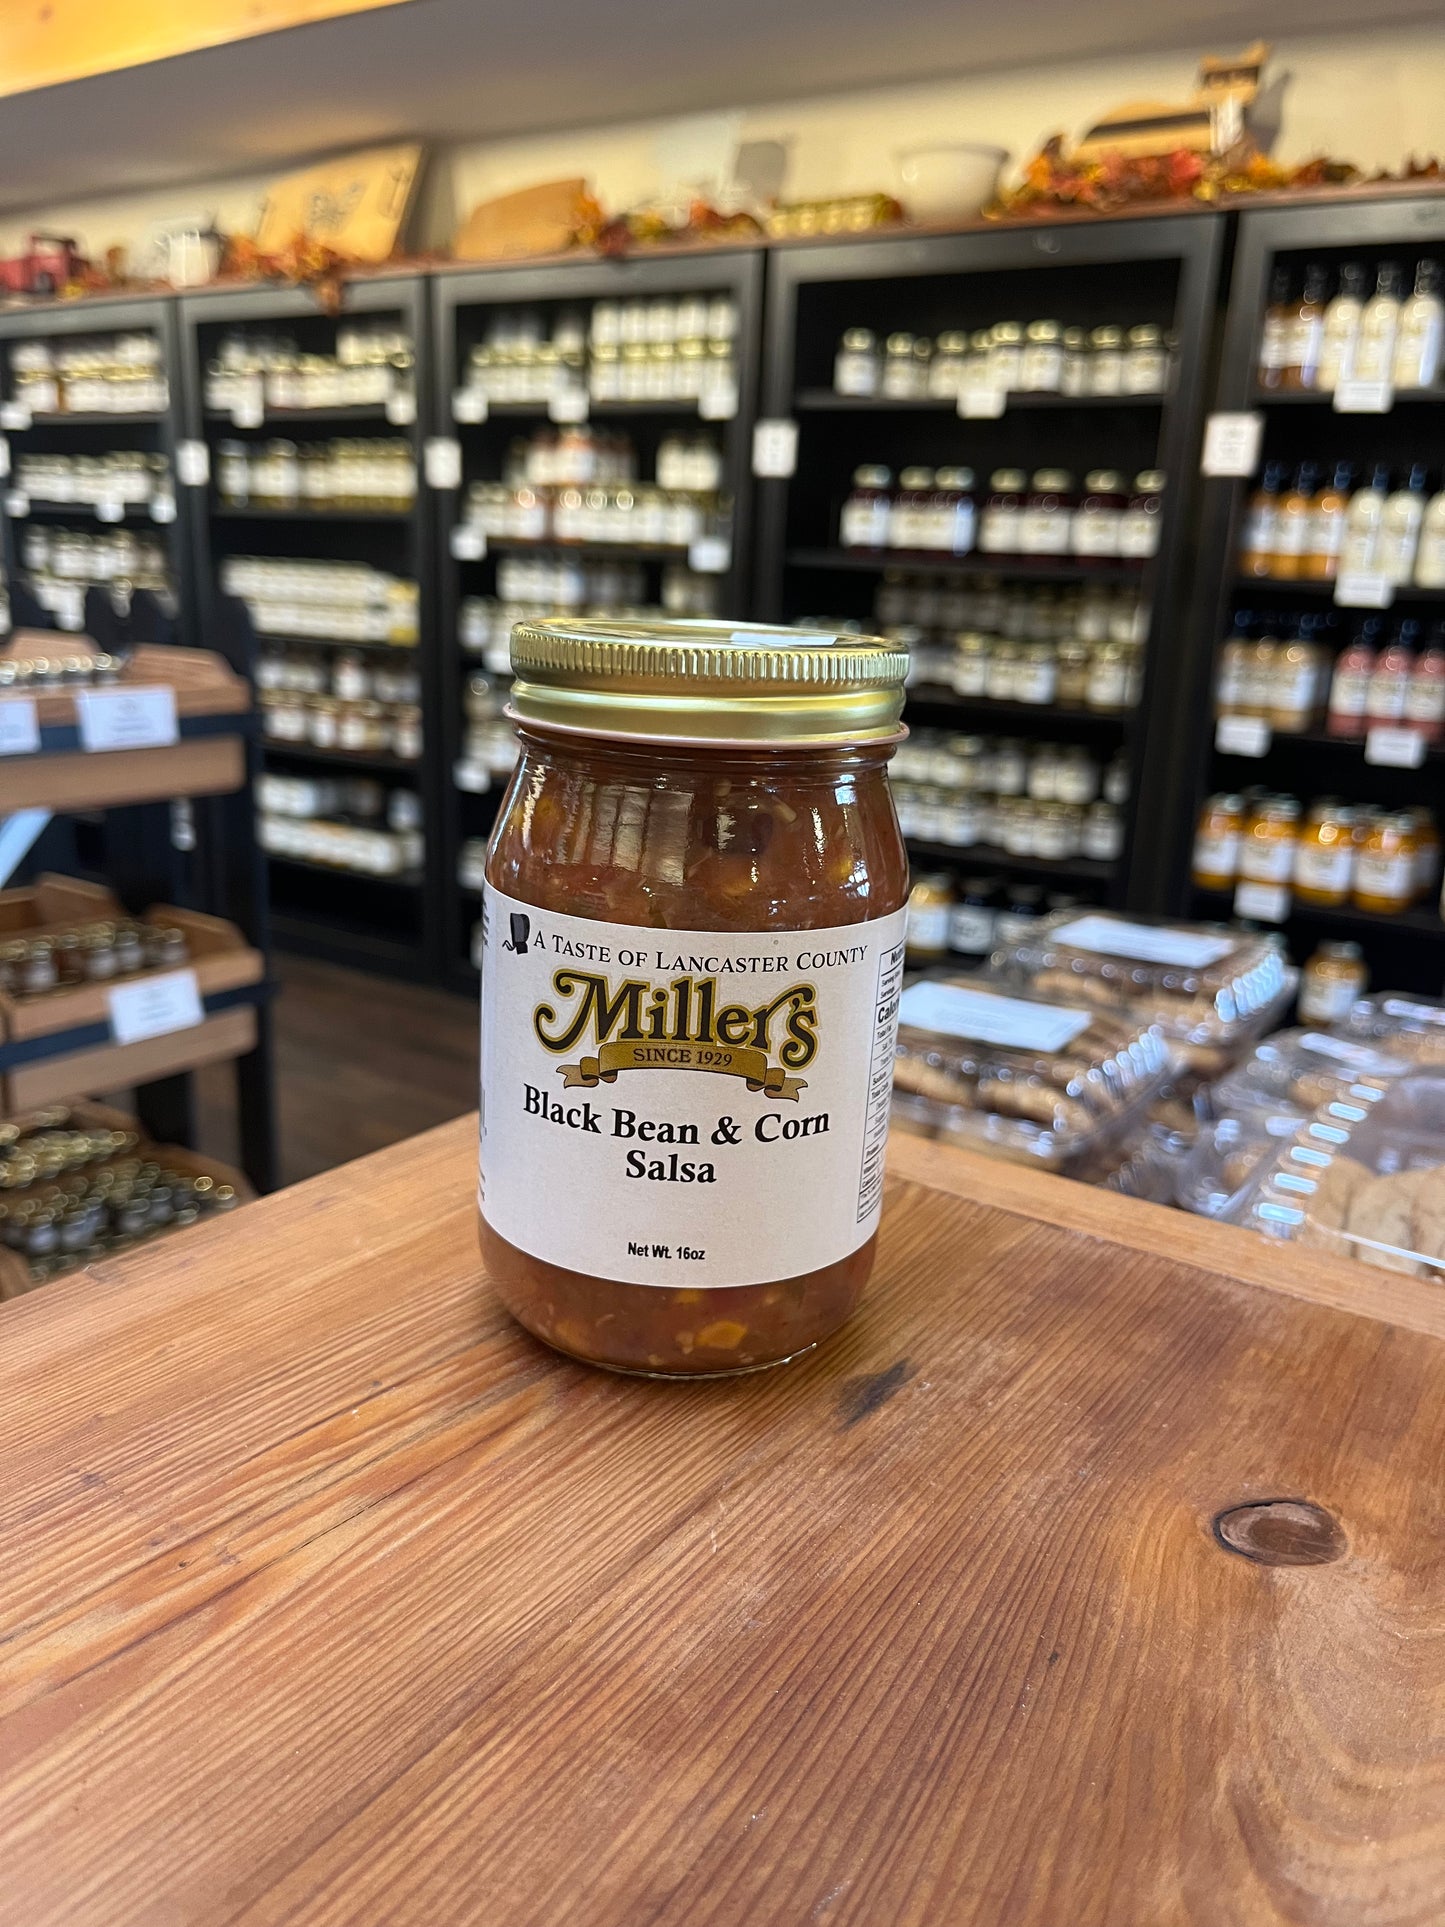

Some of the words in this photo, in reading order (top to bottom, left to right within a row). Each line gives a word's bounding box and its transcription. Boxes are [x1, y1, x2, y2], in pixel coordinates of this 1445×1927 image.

[533, 931, 547, 949] A
[534, 968, 819, 1070] Miller's
[633, 1047, 691, 1064] SINCE
[697, 1050, 733, 1066] 1929
[523, 1083, 601, 1134] Black
[610, 1108, 700, 1145] Bean
[711, 1116, 743, 1146] &
[754, 1111, 830, 1143] Corn
[625, 1149, 717, 1184] Salsa
[627, 1242, 650, 1257] Net
[652, 1245, 672, 1259] Wt.
[676, 1246, 705, 1260] 16oz
